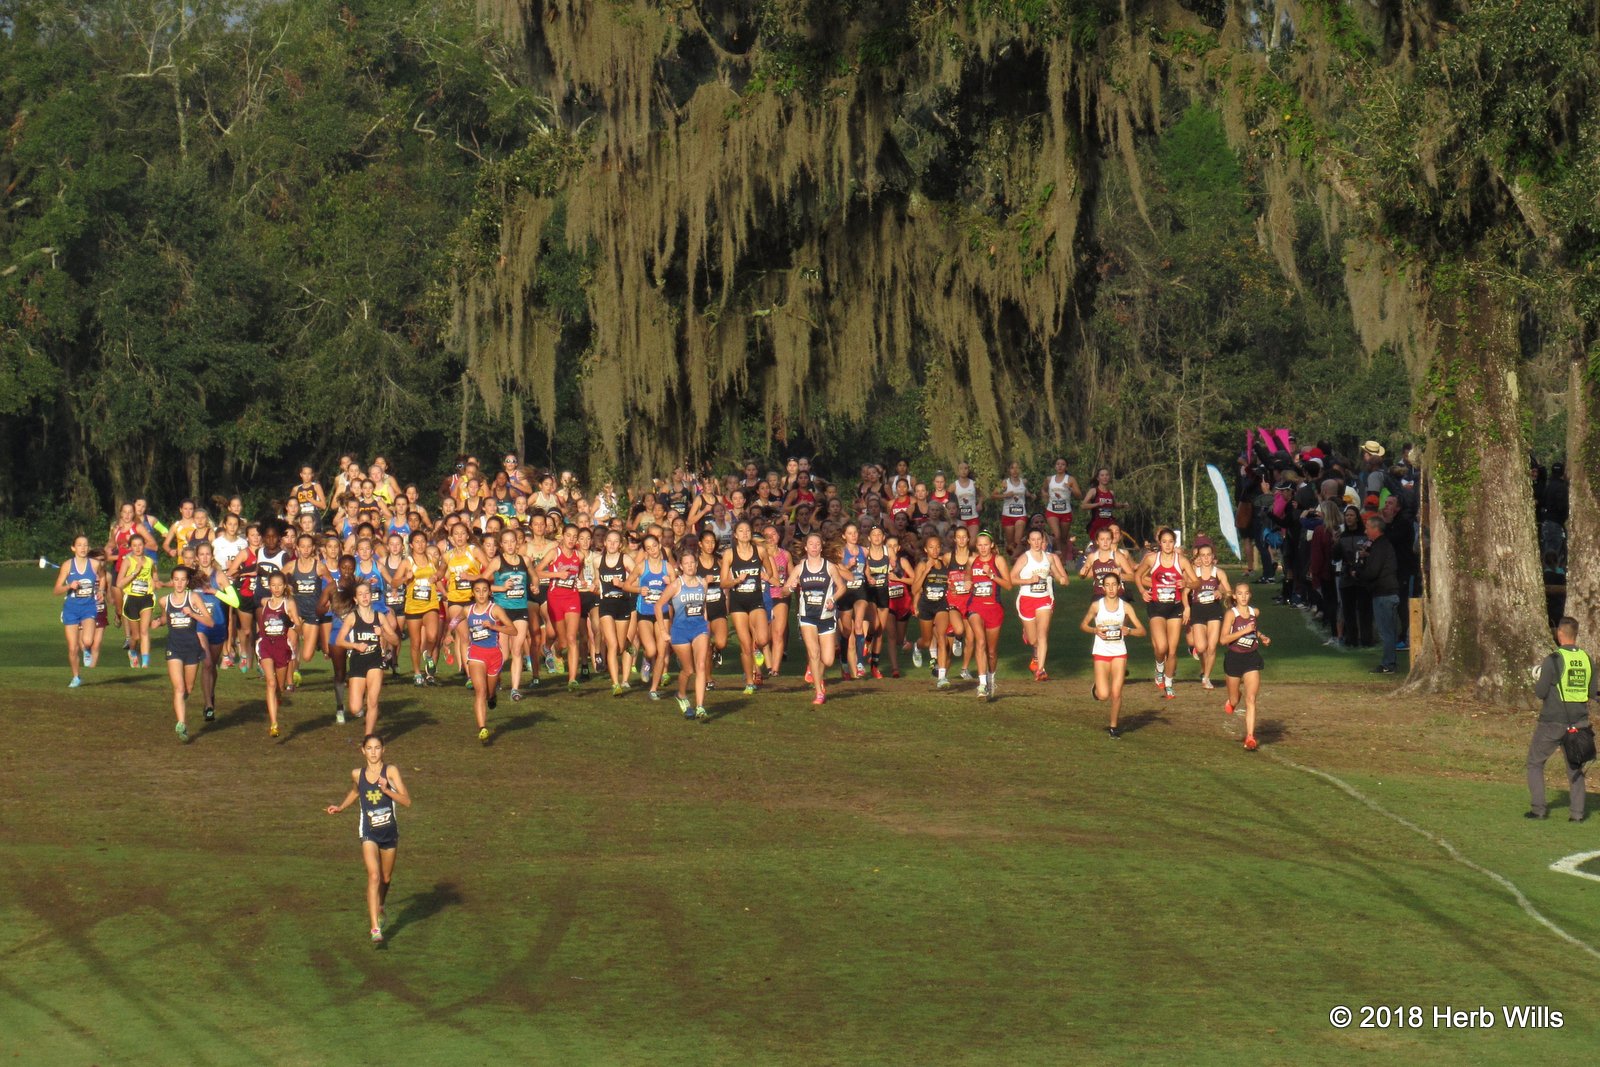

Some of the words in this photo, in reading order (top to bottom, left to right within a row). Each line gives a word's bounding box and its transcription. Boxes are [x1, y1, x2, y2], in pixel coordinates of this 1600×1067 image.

[600, 574, 623, 583] LOPZ
[680, 593, 705, 603] CIRCL
[688, 606, 701, 614] 217
[371, 812, 392, 825] 557
